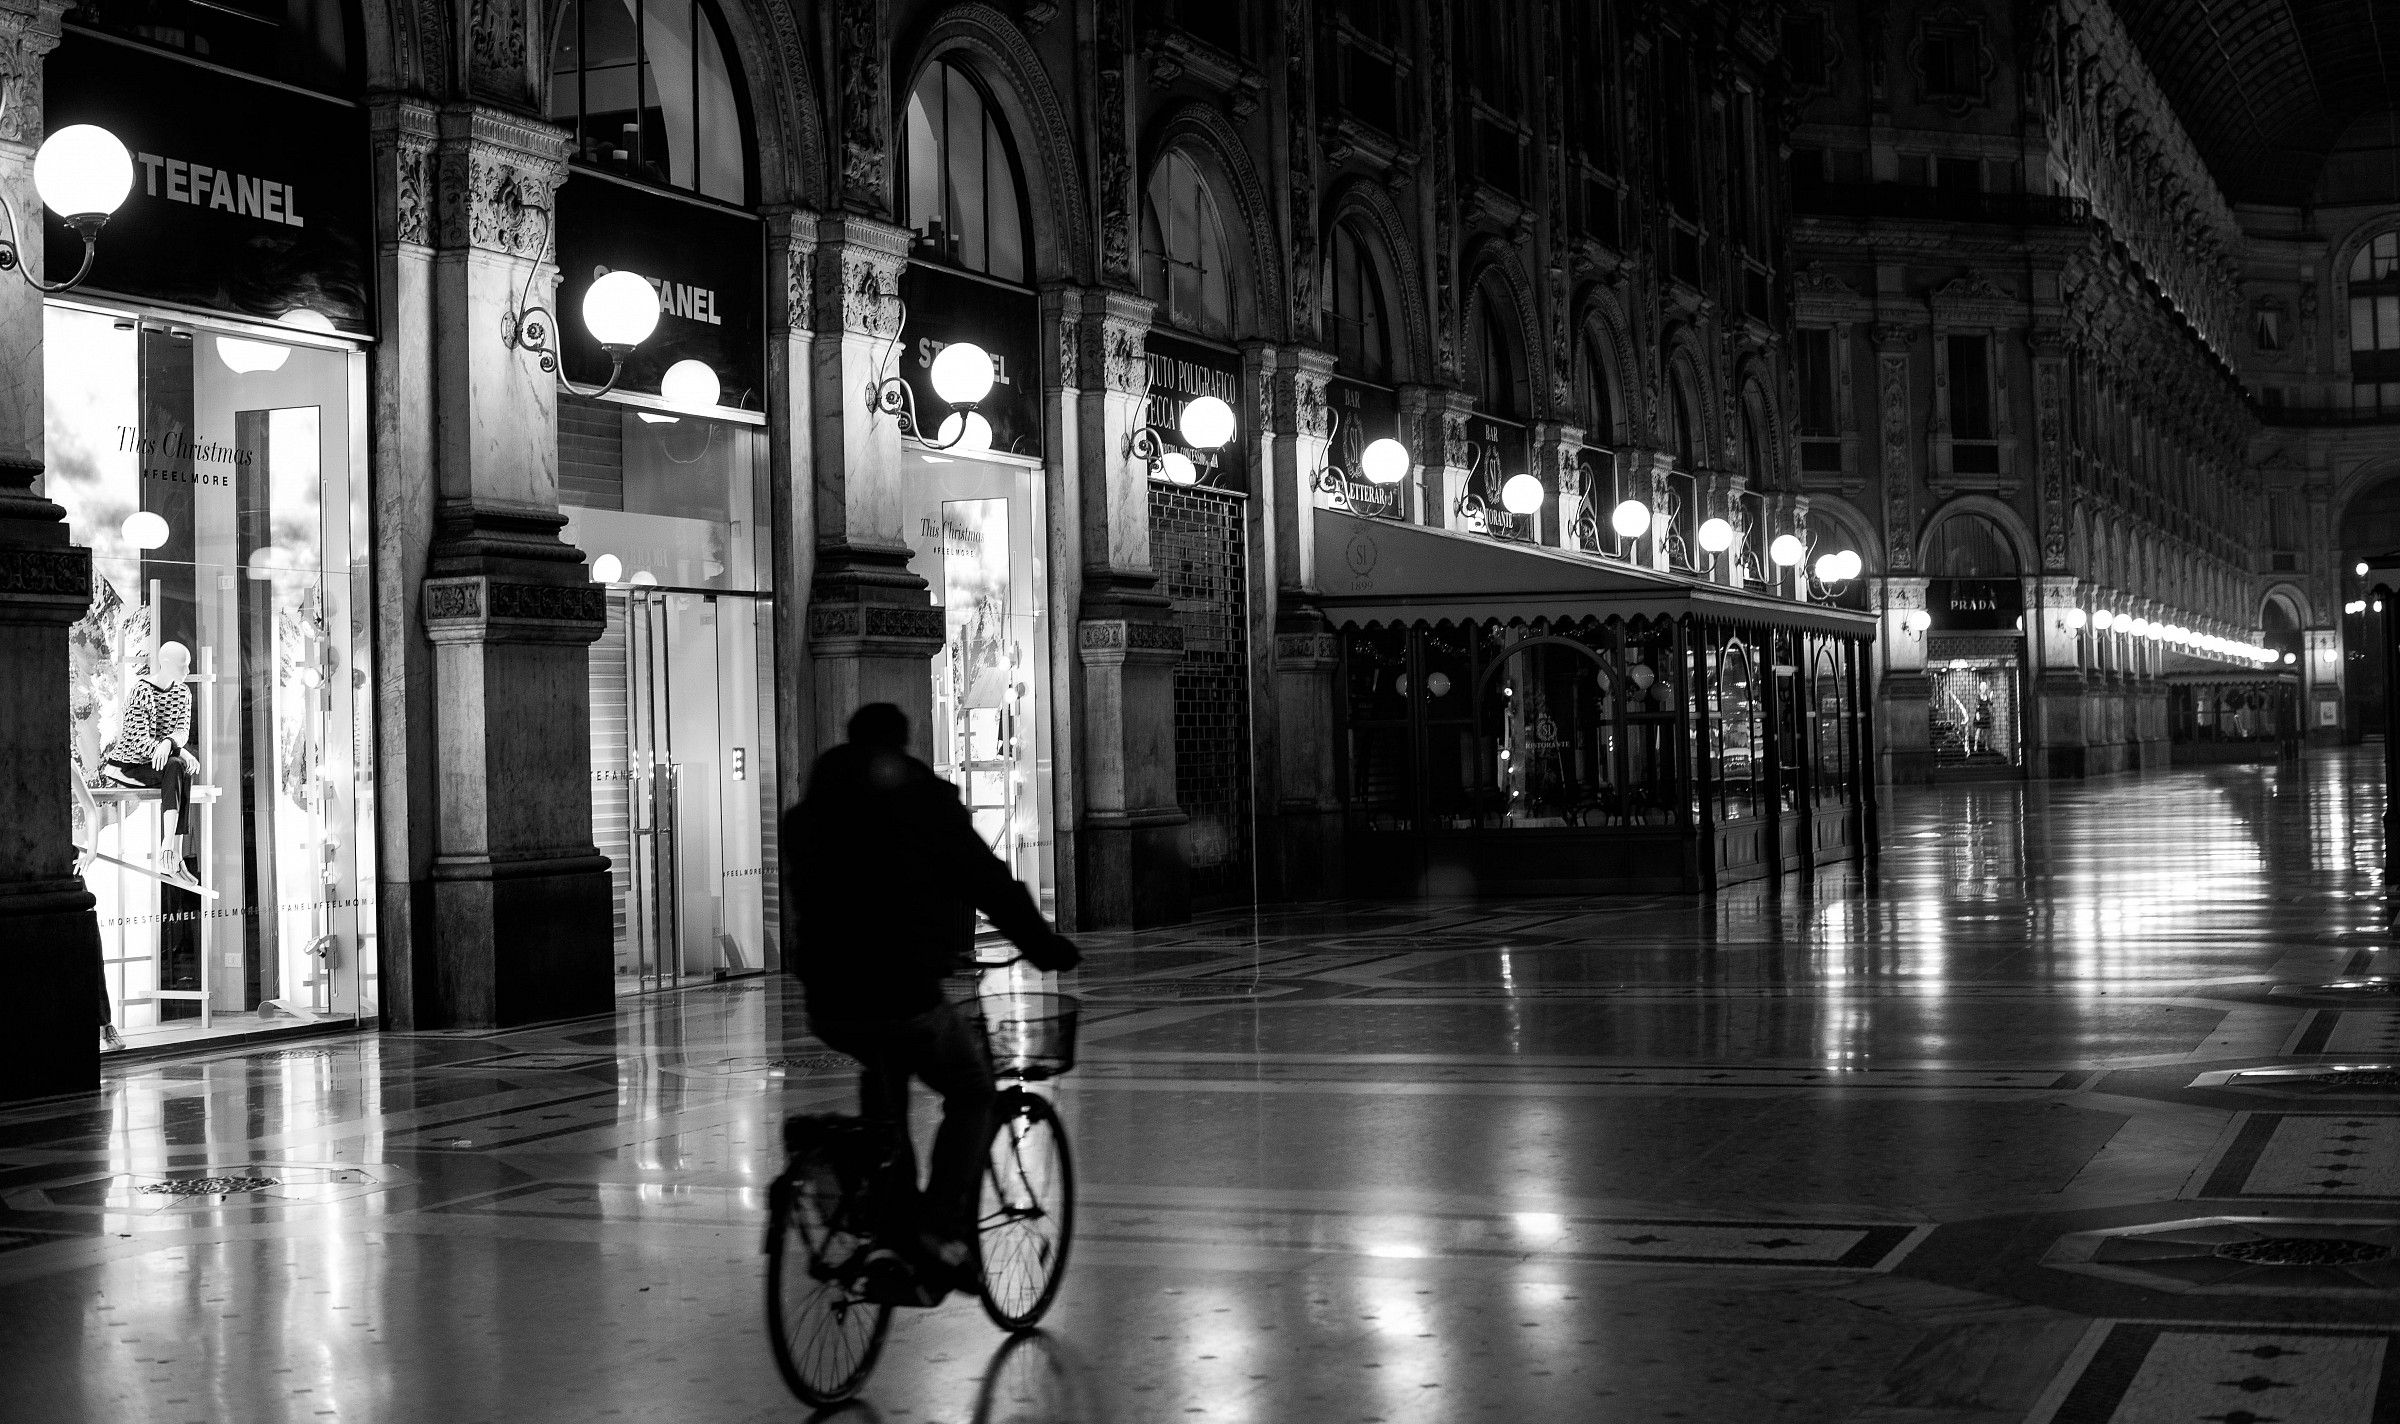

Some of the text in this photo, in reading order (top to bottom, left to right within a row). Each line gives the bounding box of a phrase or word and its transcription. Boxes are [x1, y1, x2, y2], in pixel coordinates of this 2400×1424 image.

[132, 150, 304, 228] TEFANEL
[1178, 359, 1236, 405] POLIGRAFICO
[1344, 388, 1361, 409] BAR
[1485, 424, 1499, 443] BAR
[117, 425, 253, 466] This Christmas
[143, 468, 229, 487] #FEELMORE
[920, 517, 985, 543] This Christmas
[1356, 544, 1367, 565] SI
[1350, 580, 1374, 592] 1899
[1950, 599, 1996, 611] PRADA
